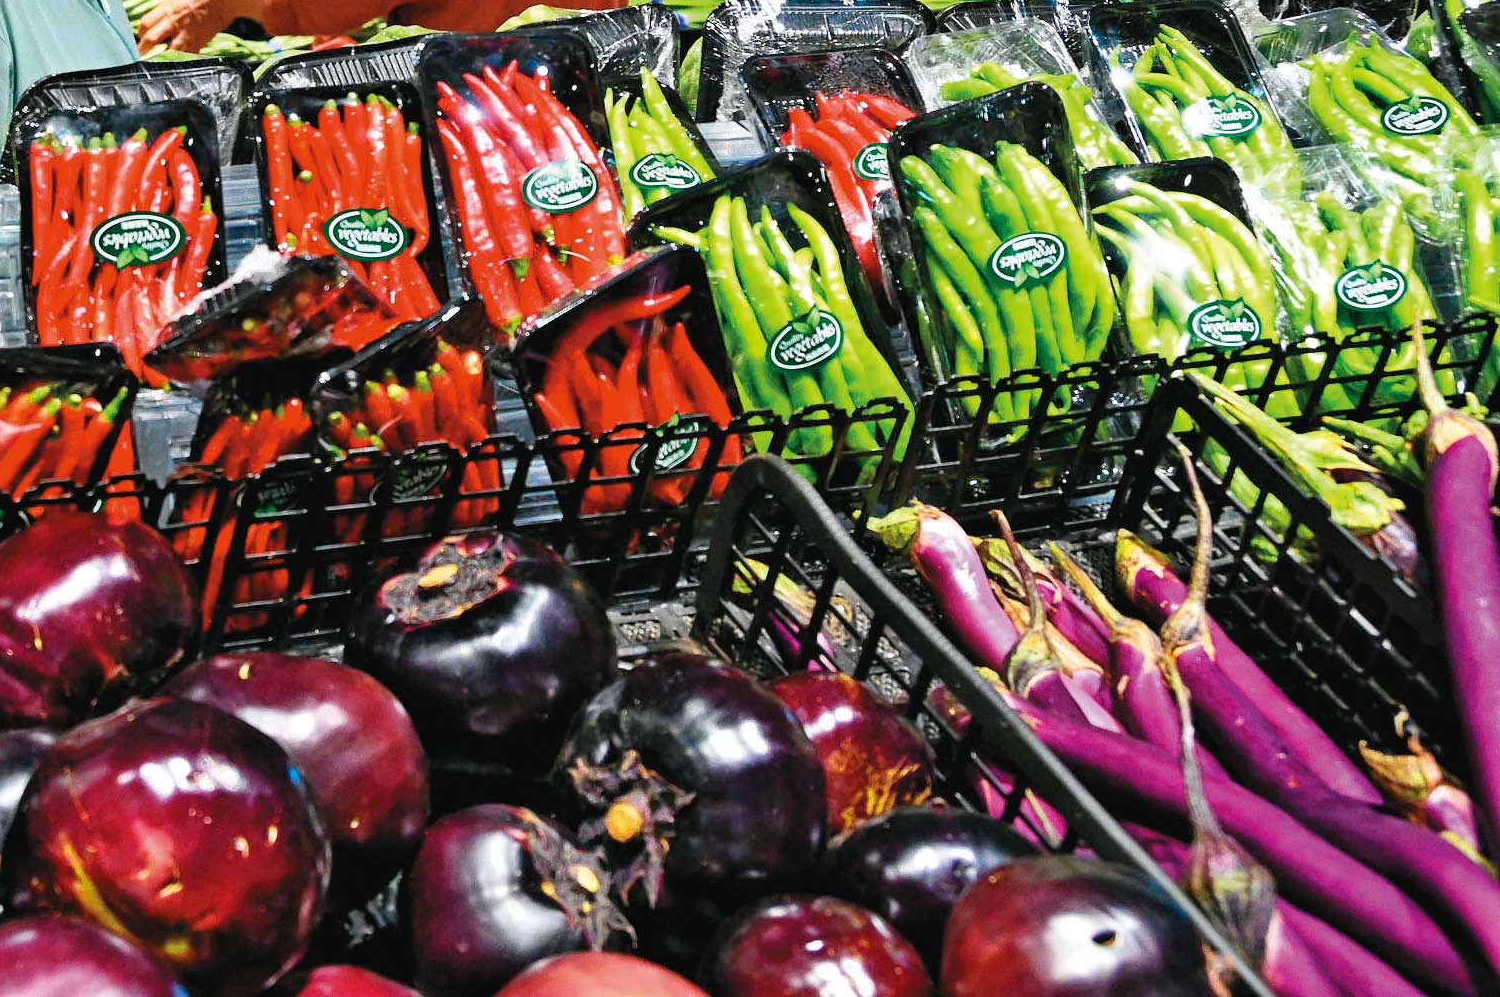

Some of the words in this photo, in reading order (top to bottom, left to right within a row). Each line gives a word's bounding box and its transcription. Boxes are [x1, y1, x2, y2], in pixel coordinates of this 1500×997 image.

[103, 222, 171, 250] vegetables
[337, 226, 398, 248] vegetables
[999, 239, 1057, 271] vegetables
